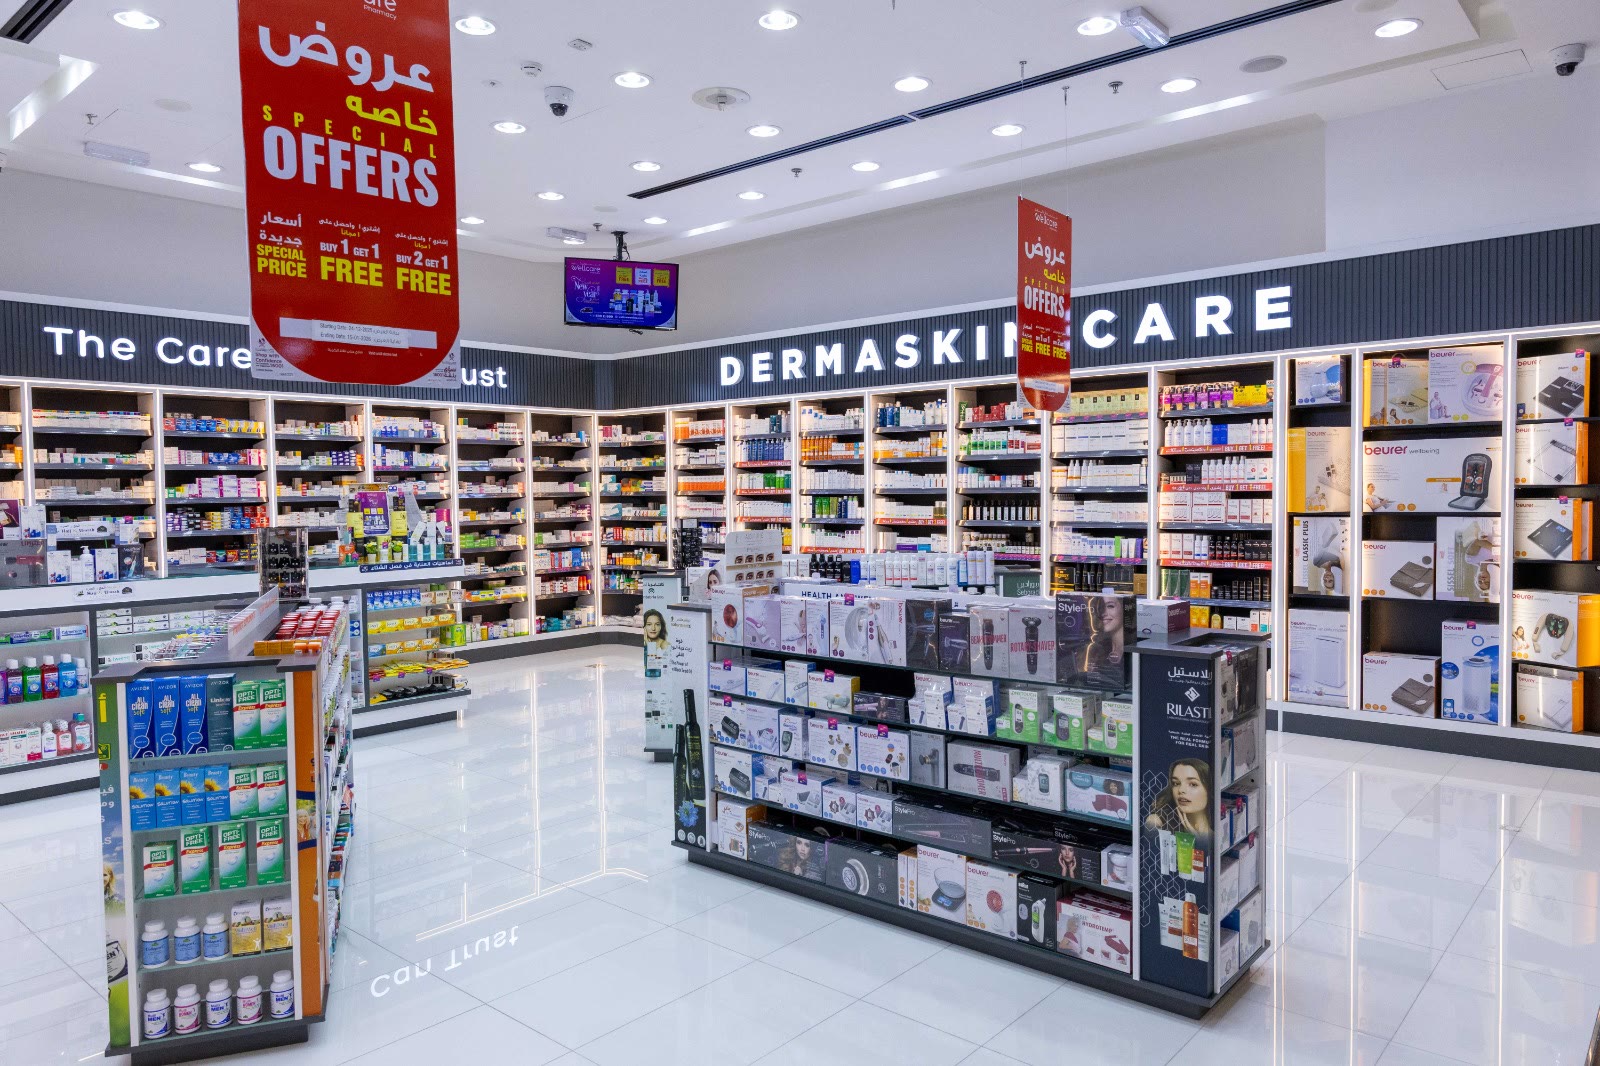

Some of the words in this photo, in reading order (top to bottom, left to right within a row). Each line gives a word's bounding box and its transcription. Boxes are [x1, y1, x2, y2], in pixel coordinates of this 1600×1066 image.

[258, 21, 434, 92] عروض
[346, 95, 438, 135] خاصه
[262, 104, 436, 158] SPECIAL
[263, 125, 439, 207] OFFERS
[256, 243, 306, 261] SPECIAL
[320, 242, 338, 253] BUY
[341, 239, 348, 255] 1
[353, 247, 369, 257] GET
[372, 243, 379, 259] 1
[1024, 236, 1066, 266] عروض
[257, 257, 307, 278] PRICE
[396, 254, 412, 264] BUY
[414, 251, 423, 267] 2
[425, 258, 439, 269] GET
[441, 255, 449, 270] 1
[320, 255, 383, 287] FREE
[396, 267, 452, 296] FREE
[1024, 276, 1065, 296] SPECIAL
[1024, 285, 1065, 319] OFFERS
[1082, 285, 1292, 350] CARE
[43, 326, 136, 361] The
[155, 336, 252, 369] Care
[461, 366, 507, 388] ust
[1036, 342, 1050, 356] FREE
[1053, 346, 1067, 360] FREE
[1364, 444, 1408, 456] beurer
[1409, 447, 1439, 455] wellbeing
[1447, 569, 1455, 591] SISSEL
[801, 591, 832, 599] HEALTH
[1443, 624, 1464, 632] beurer
[1365, 658, 1388, 666] beurer
[992, 834, 1016, 845] StylePro
[917, 848, 940, 859] beurer
[967, 866, 989, 877] beurer
